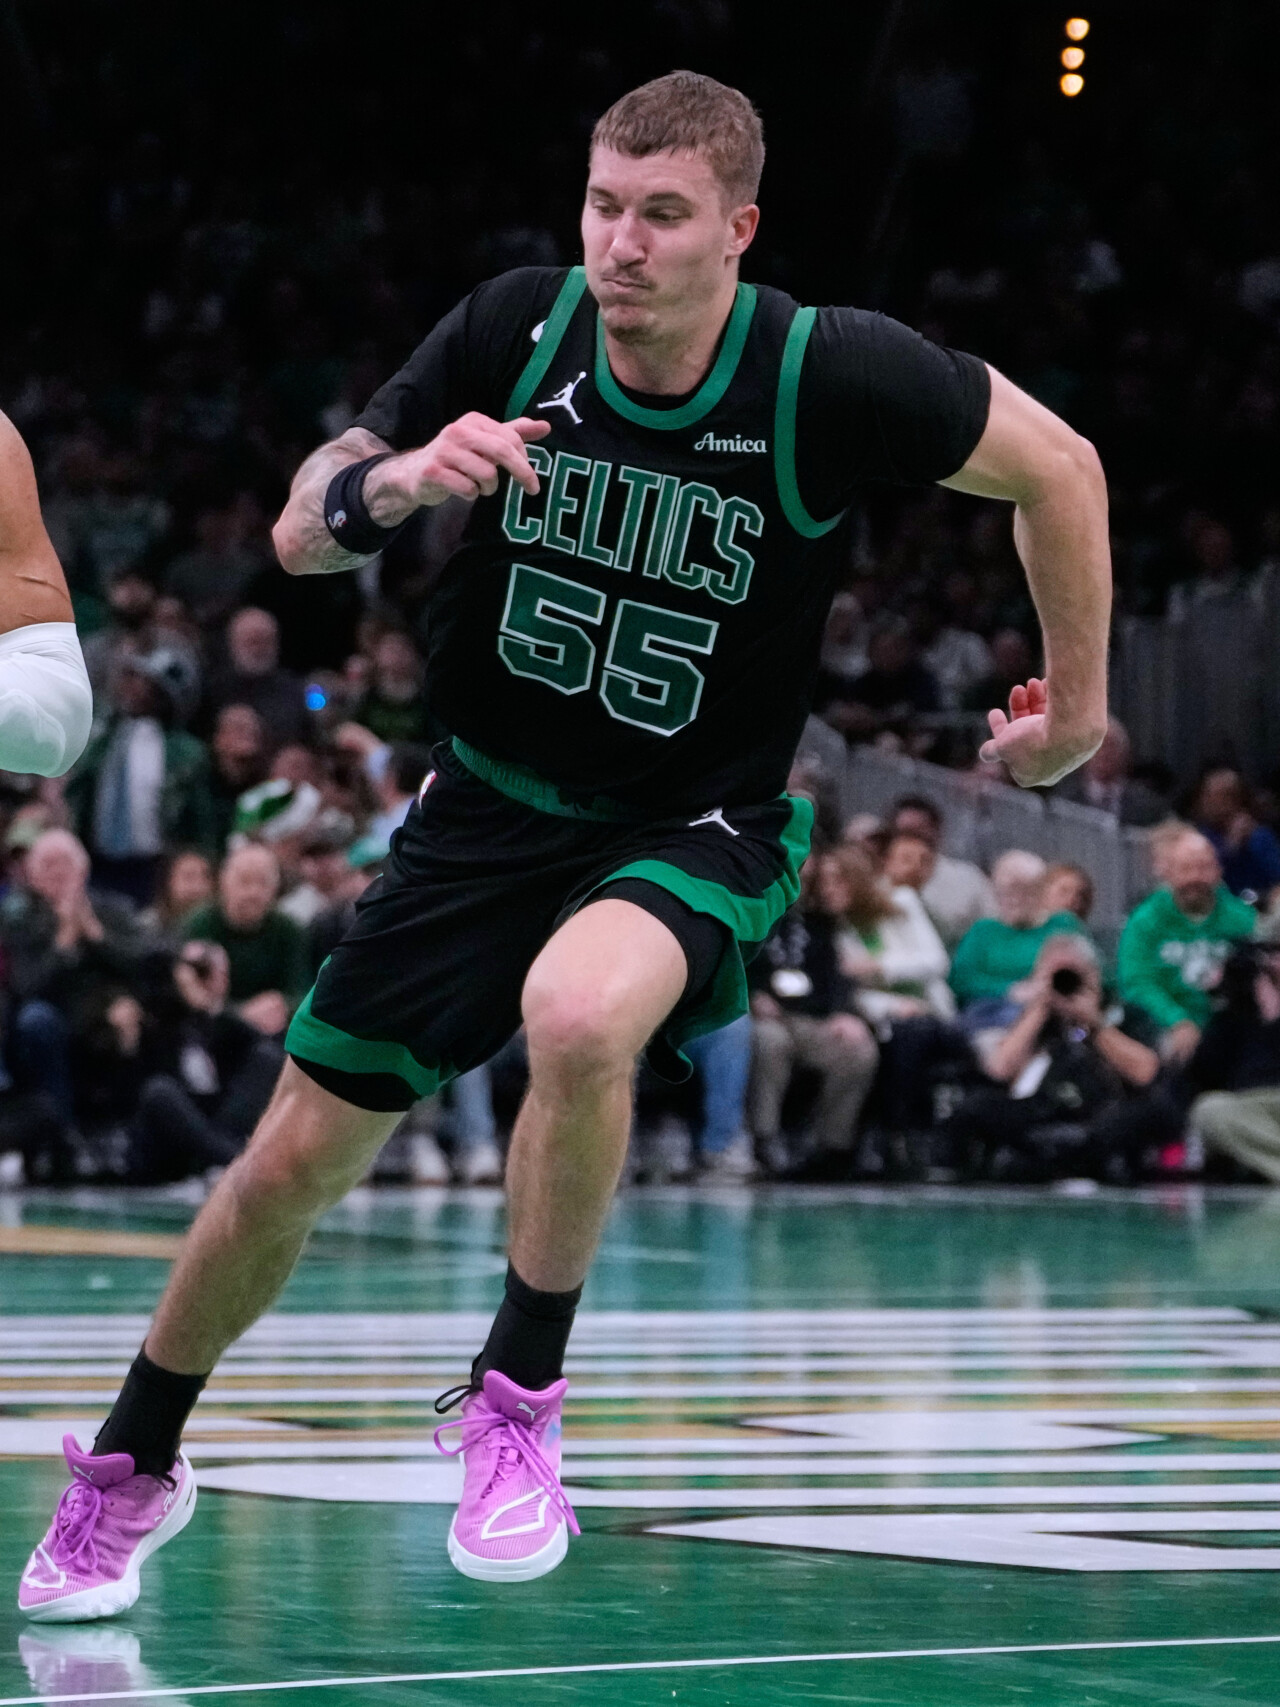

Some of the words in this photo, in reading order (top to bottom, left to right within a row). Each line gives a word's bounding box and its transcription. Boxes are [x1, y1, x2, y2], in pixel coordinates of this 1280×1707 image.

[694, 431, 767, 453] Amica
[502, 443, 764, 605] CELTICS
[498, 563, 720, 737] 55
